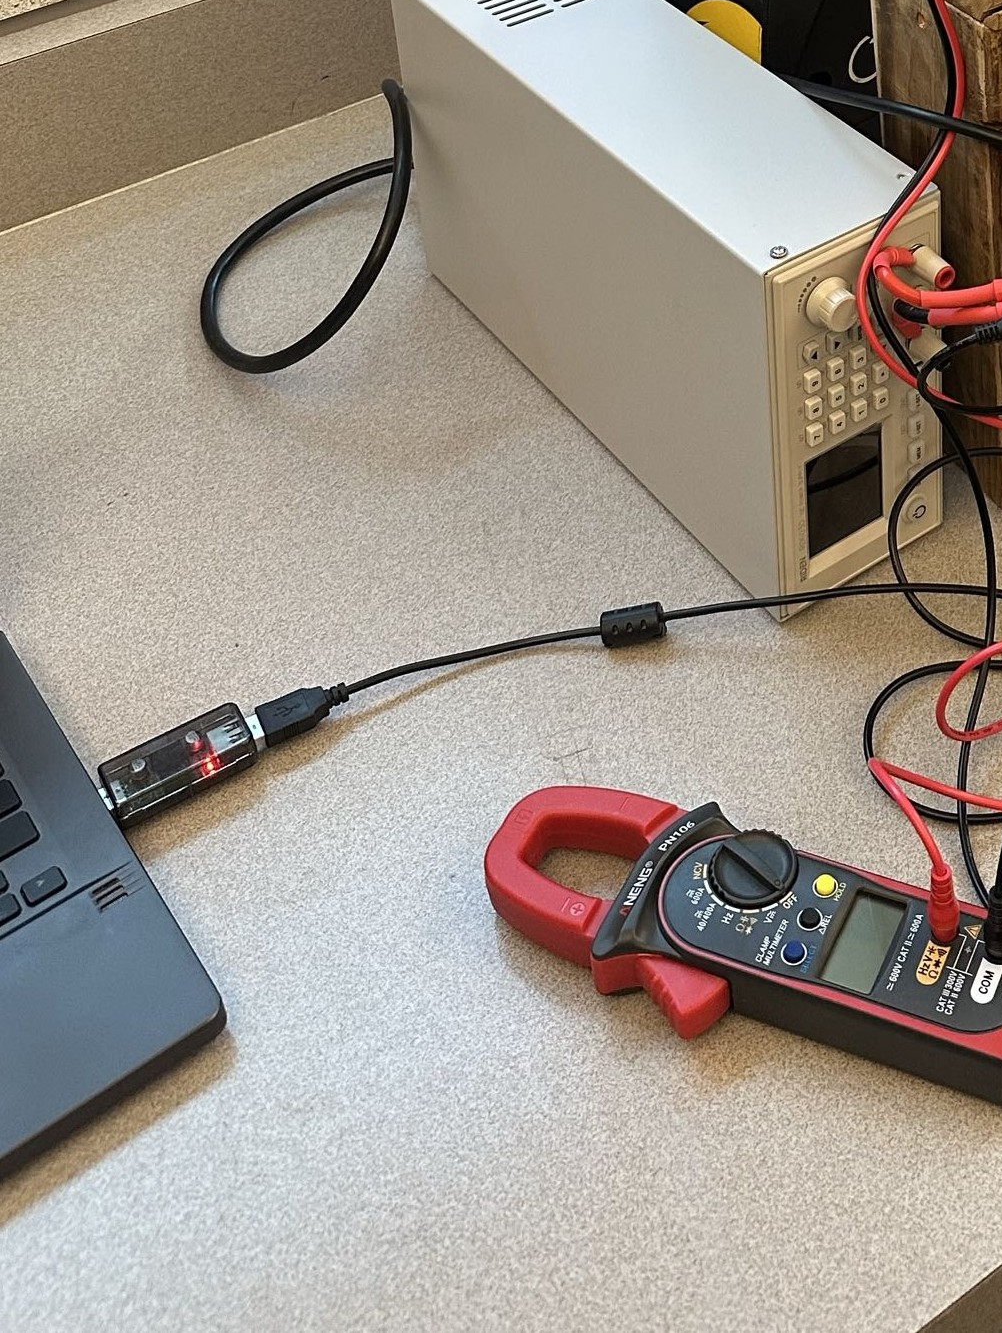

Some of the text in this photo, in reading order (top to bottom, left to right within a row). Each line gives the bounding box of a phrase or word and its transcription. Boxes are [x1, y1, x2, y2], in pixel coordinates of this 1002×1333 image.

[658, 820, 696, 852] PN106
[692, 862, 704, 881] NCV
[690, 887, 706, 906] 600A
[782, 894, 799, 910] OFF
[833, 882, 847, 902] HOLD
[720, 912, 734, 925] Hz
[755, 935, 770, 964] CLAMP
[763, 919, 790, 967] MULTIMETER
[888, 960, 905, 983] 600V
[897, 946, 909, 963] CAT
[909, 914, 924, 933] 600A
[936, 995, 947, 1012] CAT
[946, 970, 957, 990] 300V
[944, 998, 956, 1015] CAT
[954, 973, 966, 993] 600V
[978, 970, 995, 995] COM
